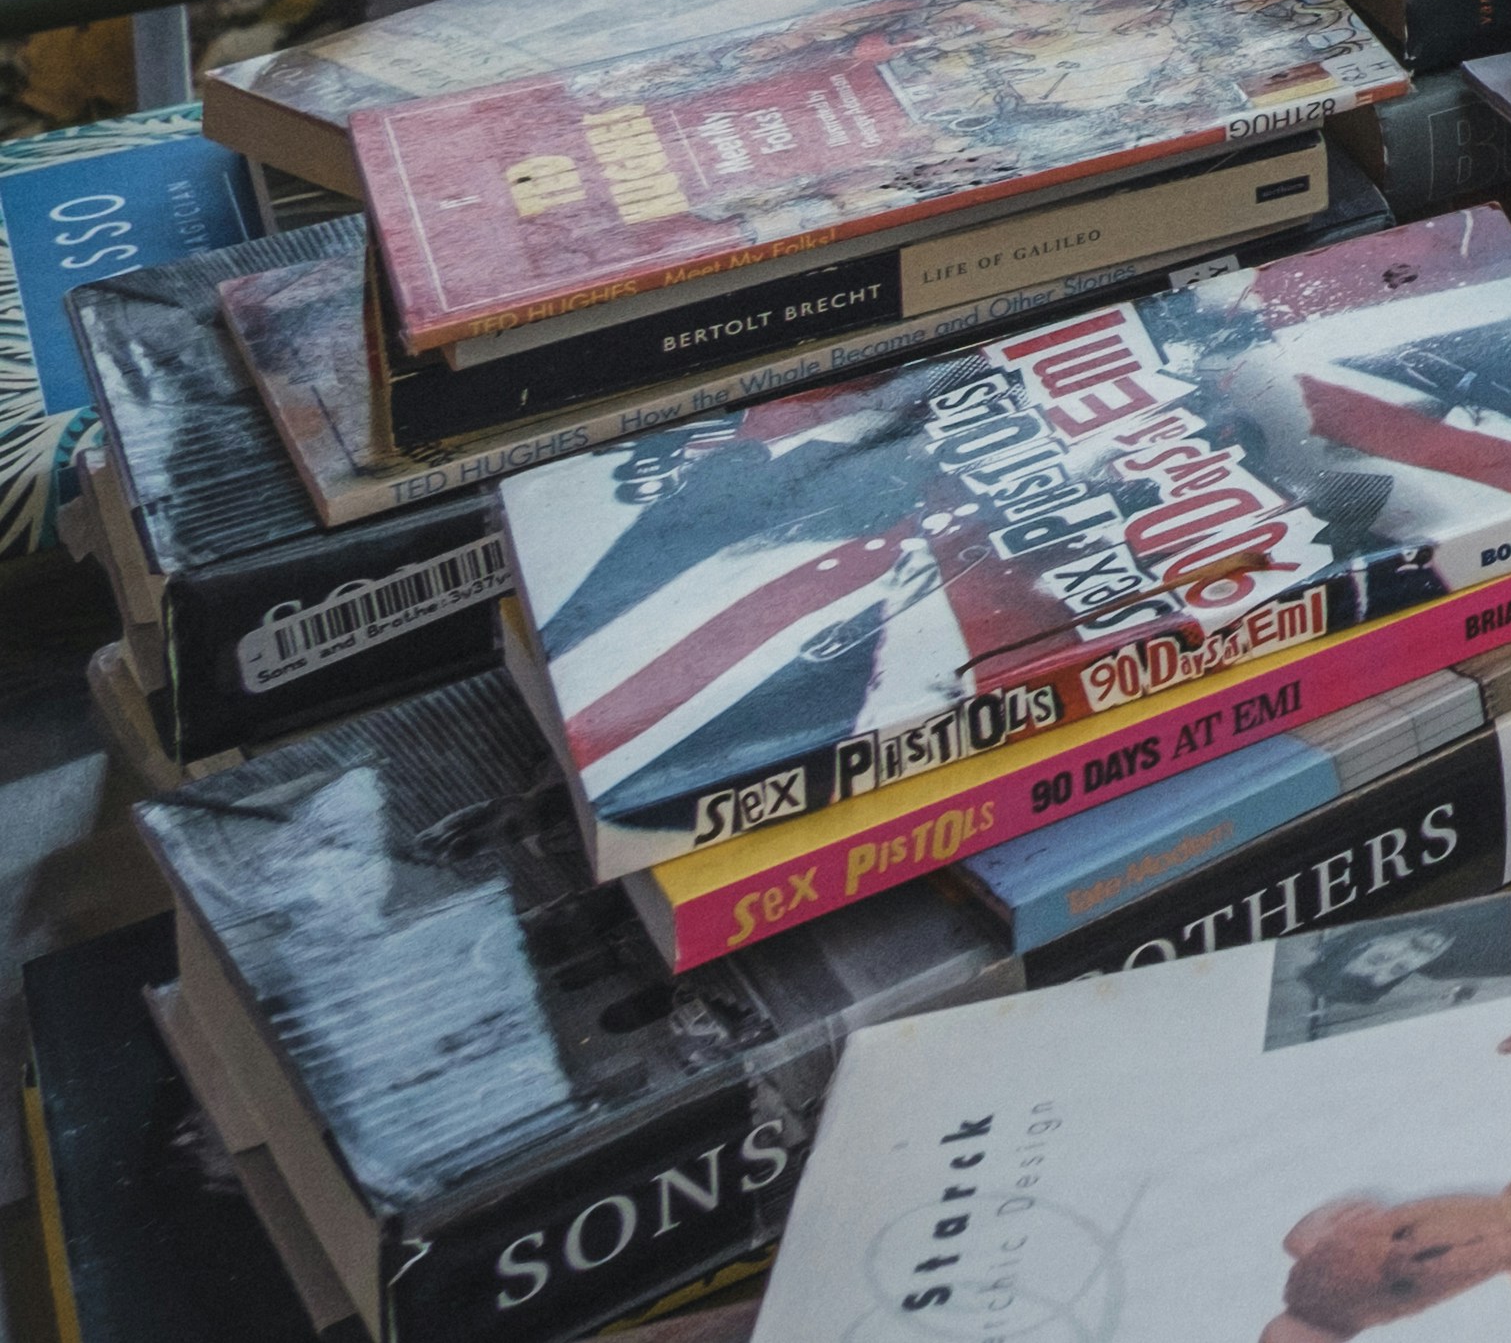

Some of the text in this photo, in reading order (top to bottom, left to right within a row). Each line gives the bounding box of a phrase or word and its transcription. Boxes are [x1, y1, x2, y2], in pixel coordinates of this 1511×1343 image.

[662, 228, 1101, 354] BERTOLT BRECHT LIFE OF GALILEO
[389, 261, 1137, 506] TED HUGHES How the Whole Became and Other Stories
[257, 638, 356, 684] Sons and
[1088, 659, 1142, 702] 90
[1031, 772, 1072, 812] 90
[1083, 737, 1161, 794] DAYS
[1170, 715, 1223, 759] AT
[1232, 681, 1302, 735] EMI
[496, 1115, 791, 1313] SONS
[901, 1113, 996, 1312] Starck
[996, 1100, 1064, 1217] Design
